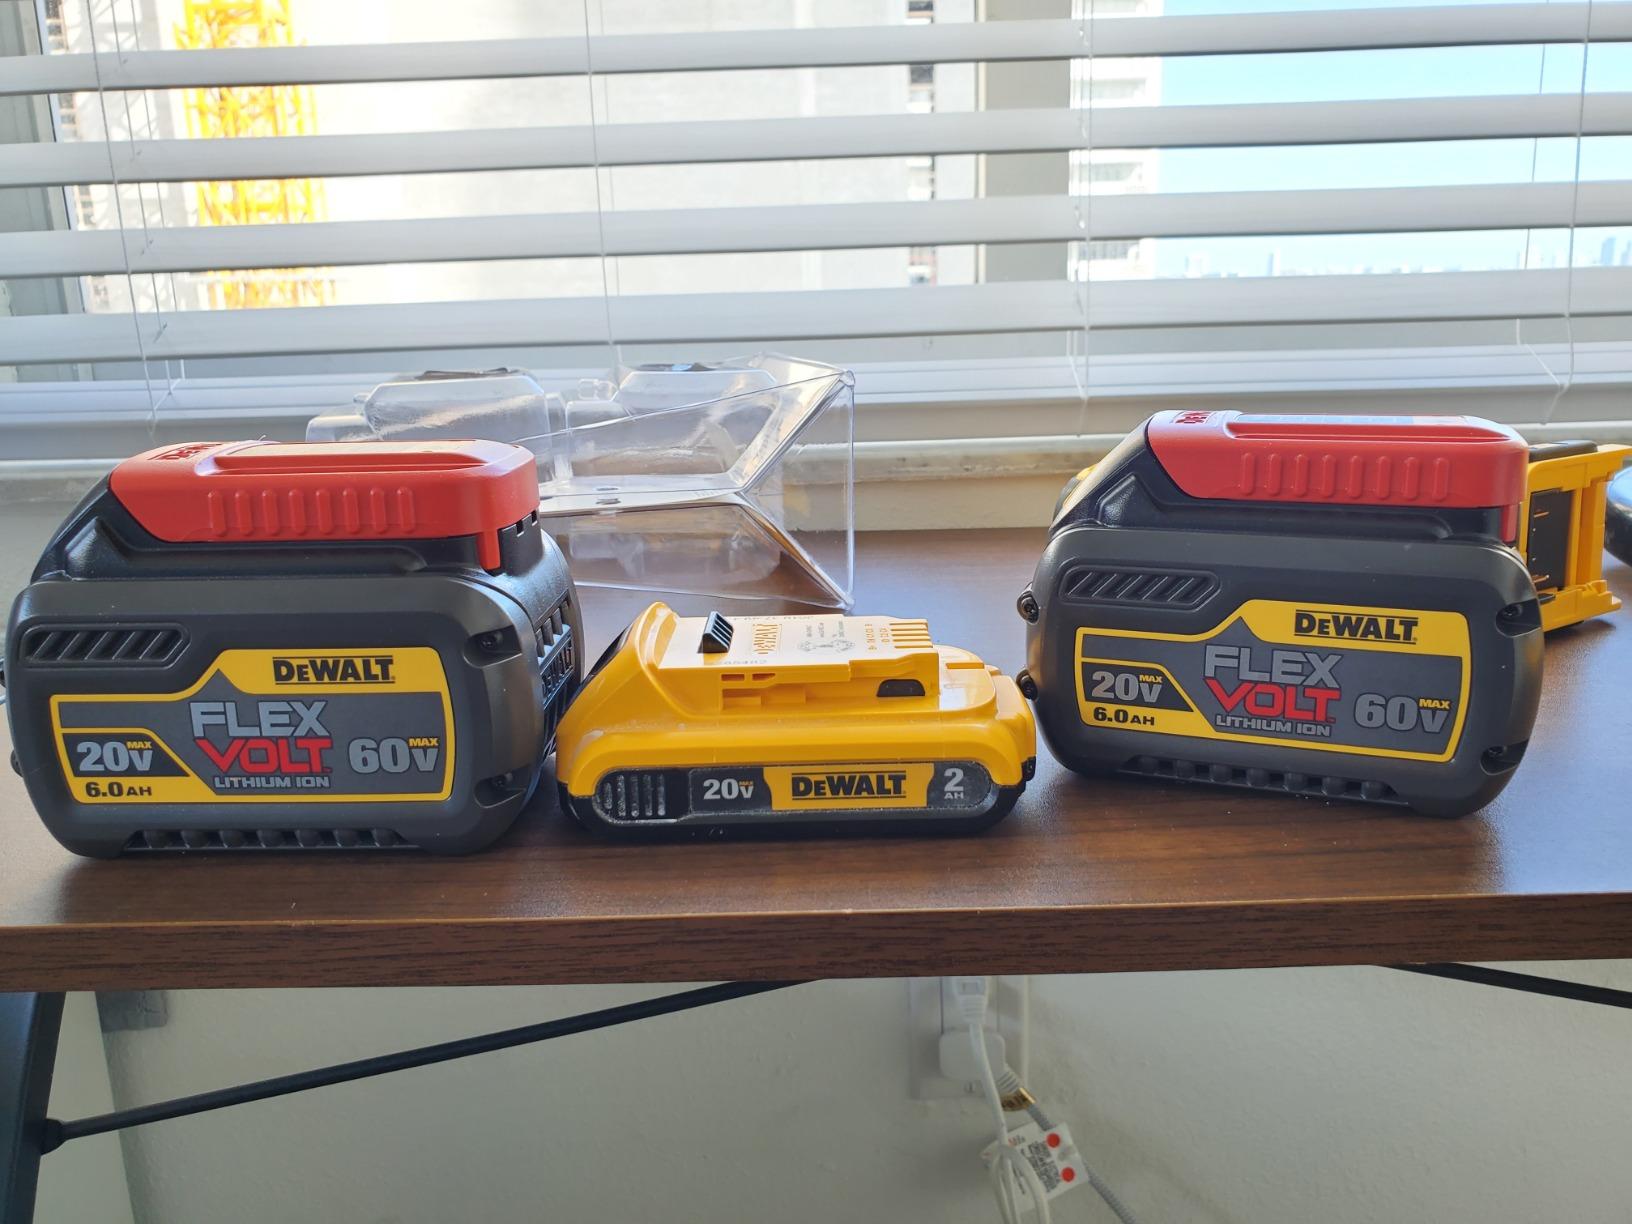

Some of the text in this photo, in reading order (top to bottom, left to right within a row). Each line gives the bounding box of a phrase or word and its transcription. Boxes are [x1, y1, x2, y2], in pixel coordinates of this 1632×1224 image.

[1294, 611, 1418, 643] DEWALT
[273, 657, 396, 684] DEWALT
[1204, 644, 1342, 688] FLEX
[1090, 670, 1162, 702] 20V MAX
[1204, 678, 1342, 723] VOLT
[188, 700, 330, 738] FLEX
[1093, 706, 1155, 726] 6.0 AH
[1216, 713, 1331, 738] LITHIUM ION
[1353, 692, 1452, 734] 60V MAX
[76, 740, 153, 772] 20V MAX
[194, 737, 332, 774] VOLT
[347, 737, 440, 774] 60V MAX
[85, 782, 152, 798] 6.0 AH
[213, 775, 331, 789] LITHIUM ION
[703, 777, 754, 800] 20V
[791, 773, 907, 799] DEWALT
[943, 767, 965, 792] 2
